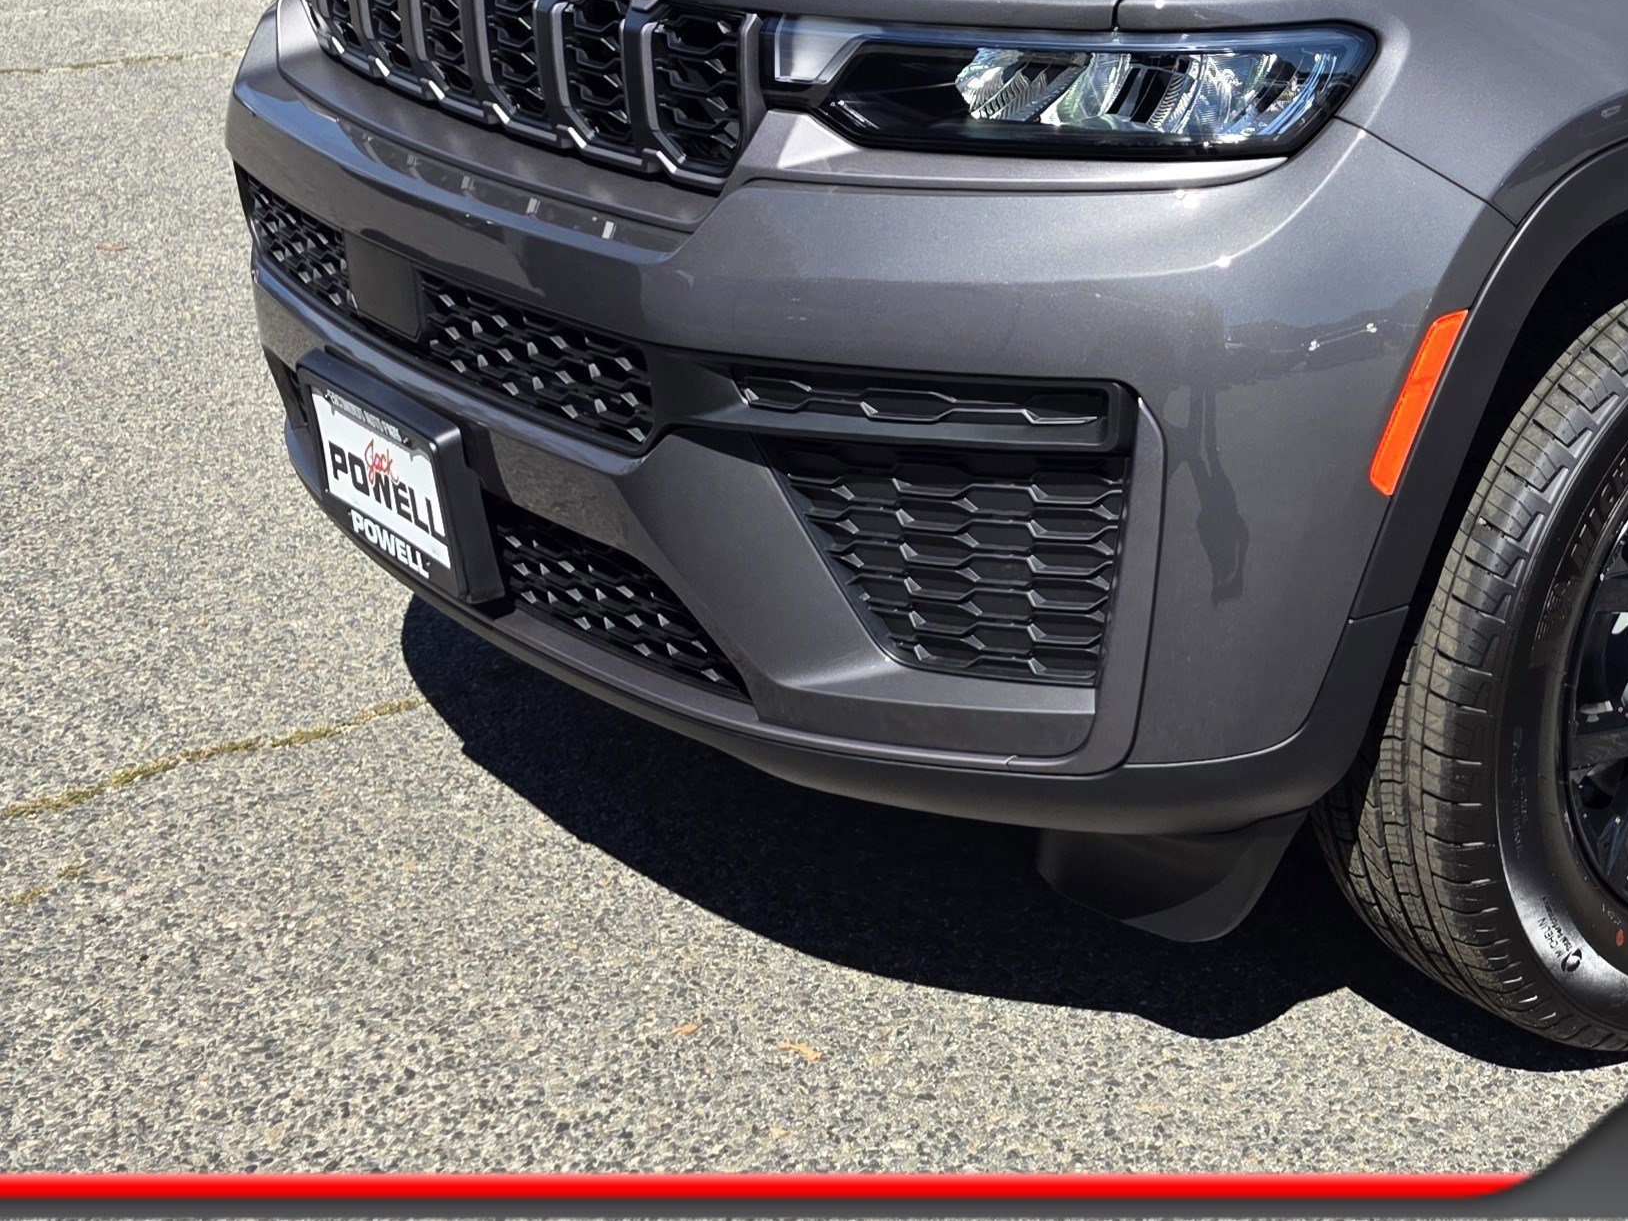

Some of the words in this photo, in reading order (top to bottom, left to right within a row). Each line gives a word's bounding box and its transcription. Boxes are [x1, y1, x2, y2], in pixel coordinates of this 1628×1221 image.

[328, 440, 449, 546] POWELL
[350, 509, 430, 579] POWELL
[1537, 917, 1564, 957] MICHELIN
